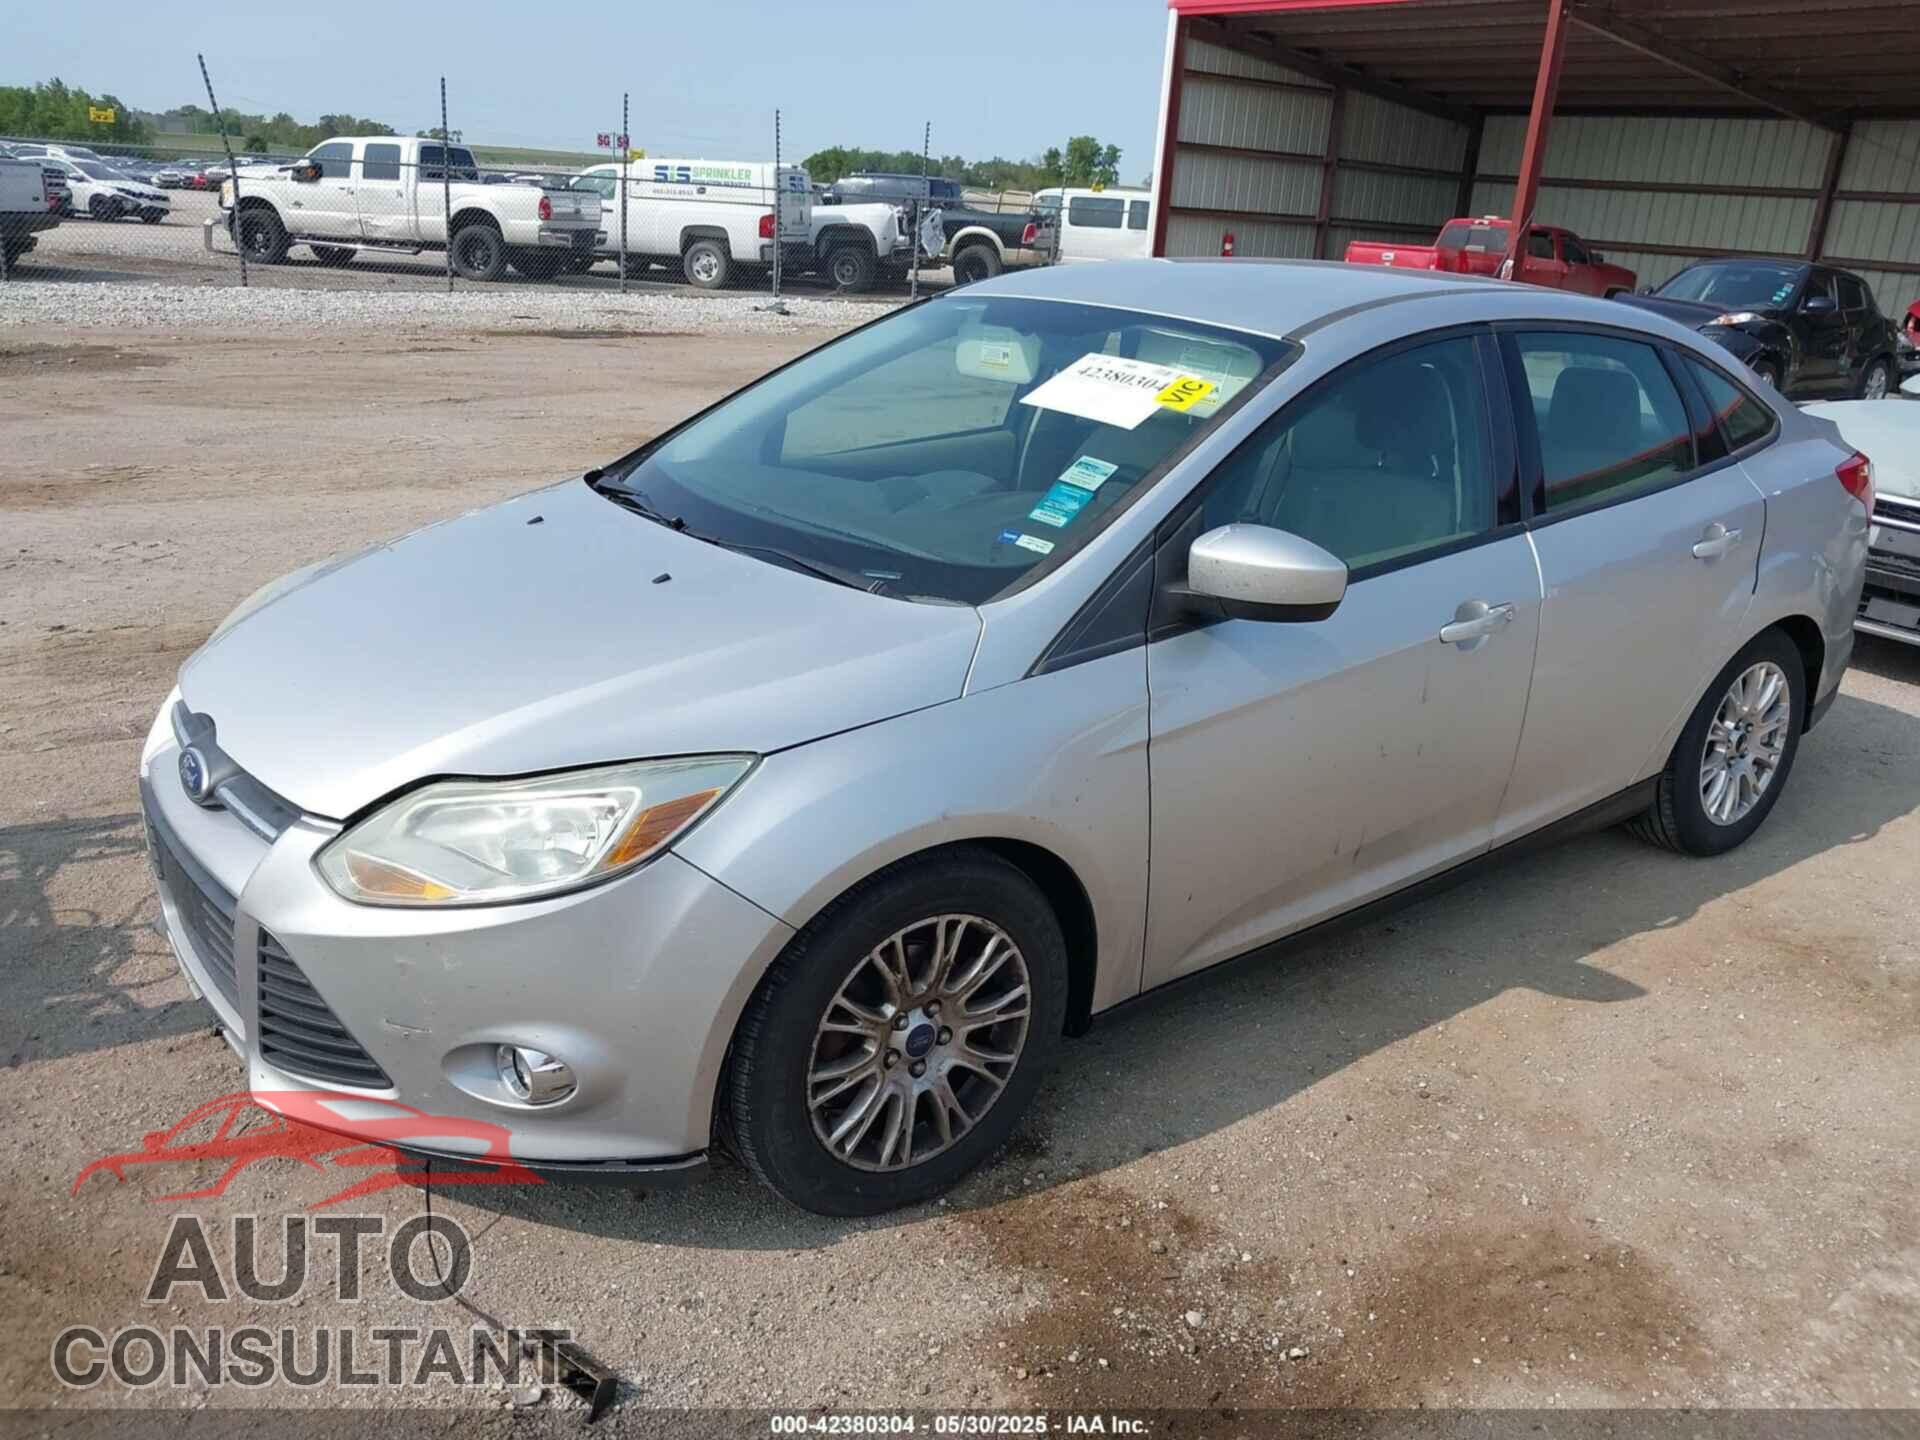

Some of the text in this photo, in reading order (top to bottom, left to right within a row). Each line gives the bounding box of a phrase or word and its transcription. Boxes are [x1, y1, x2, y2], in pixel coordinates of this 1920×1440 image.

[692, 166, 752, 180] SPRINKLER
[1077, 366, 1171, 392] 42380304
[1162, 380, 1204, 404] VIC
